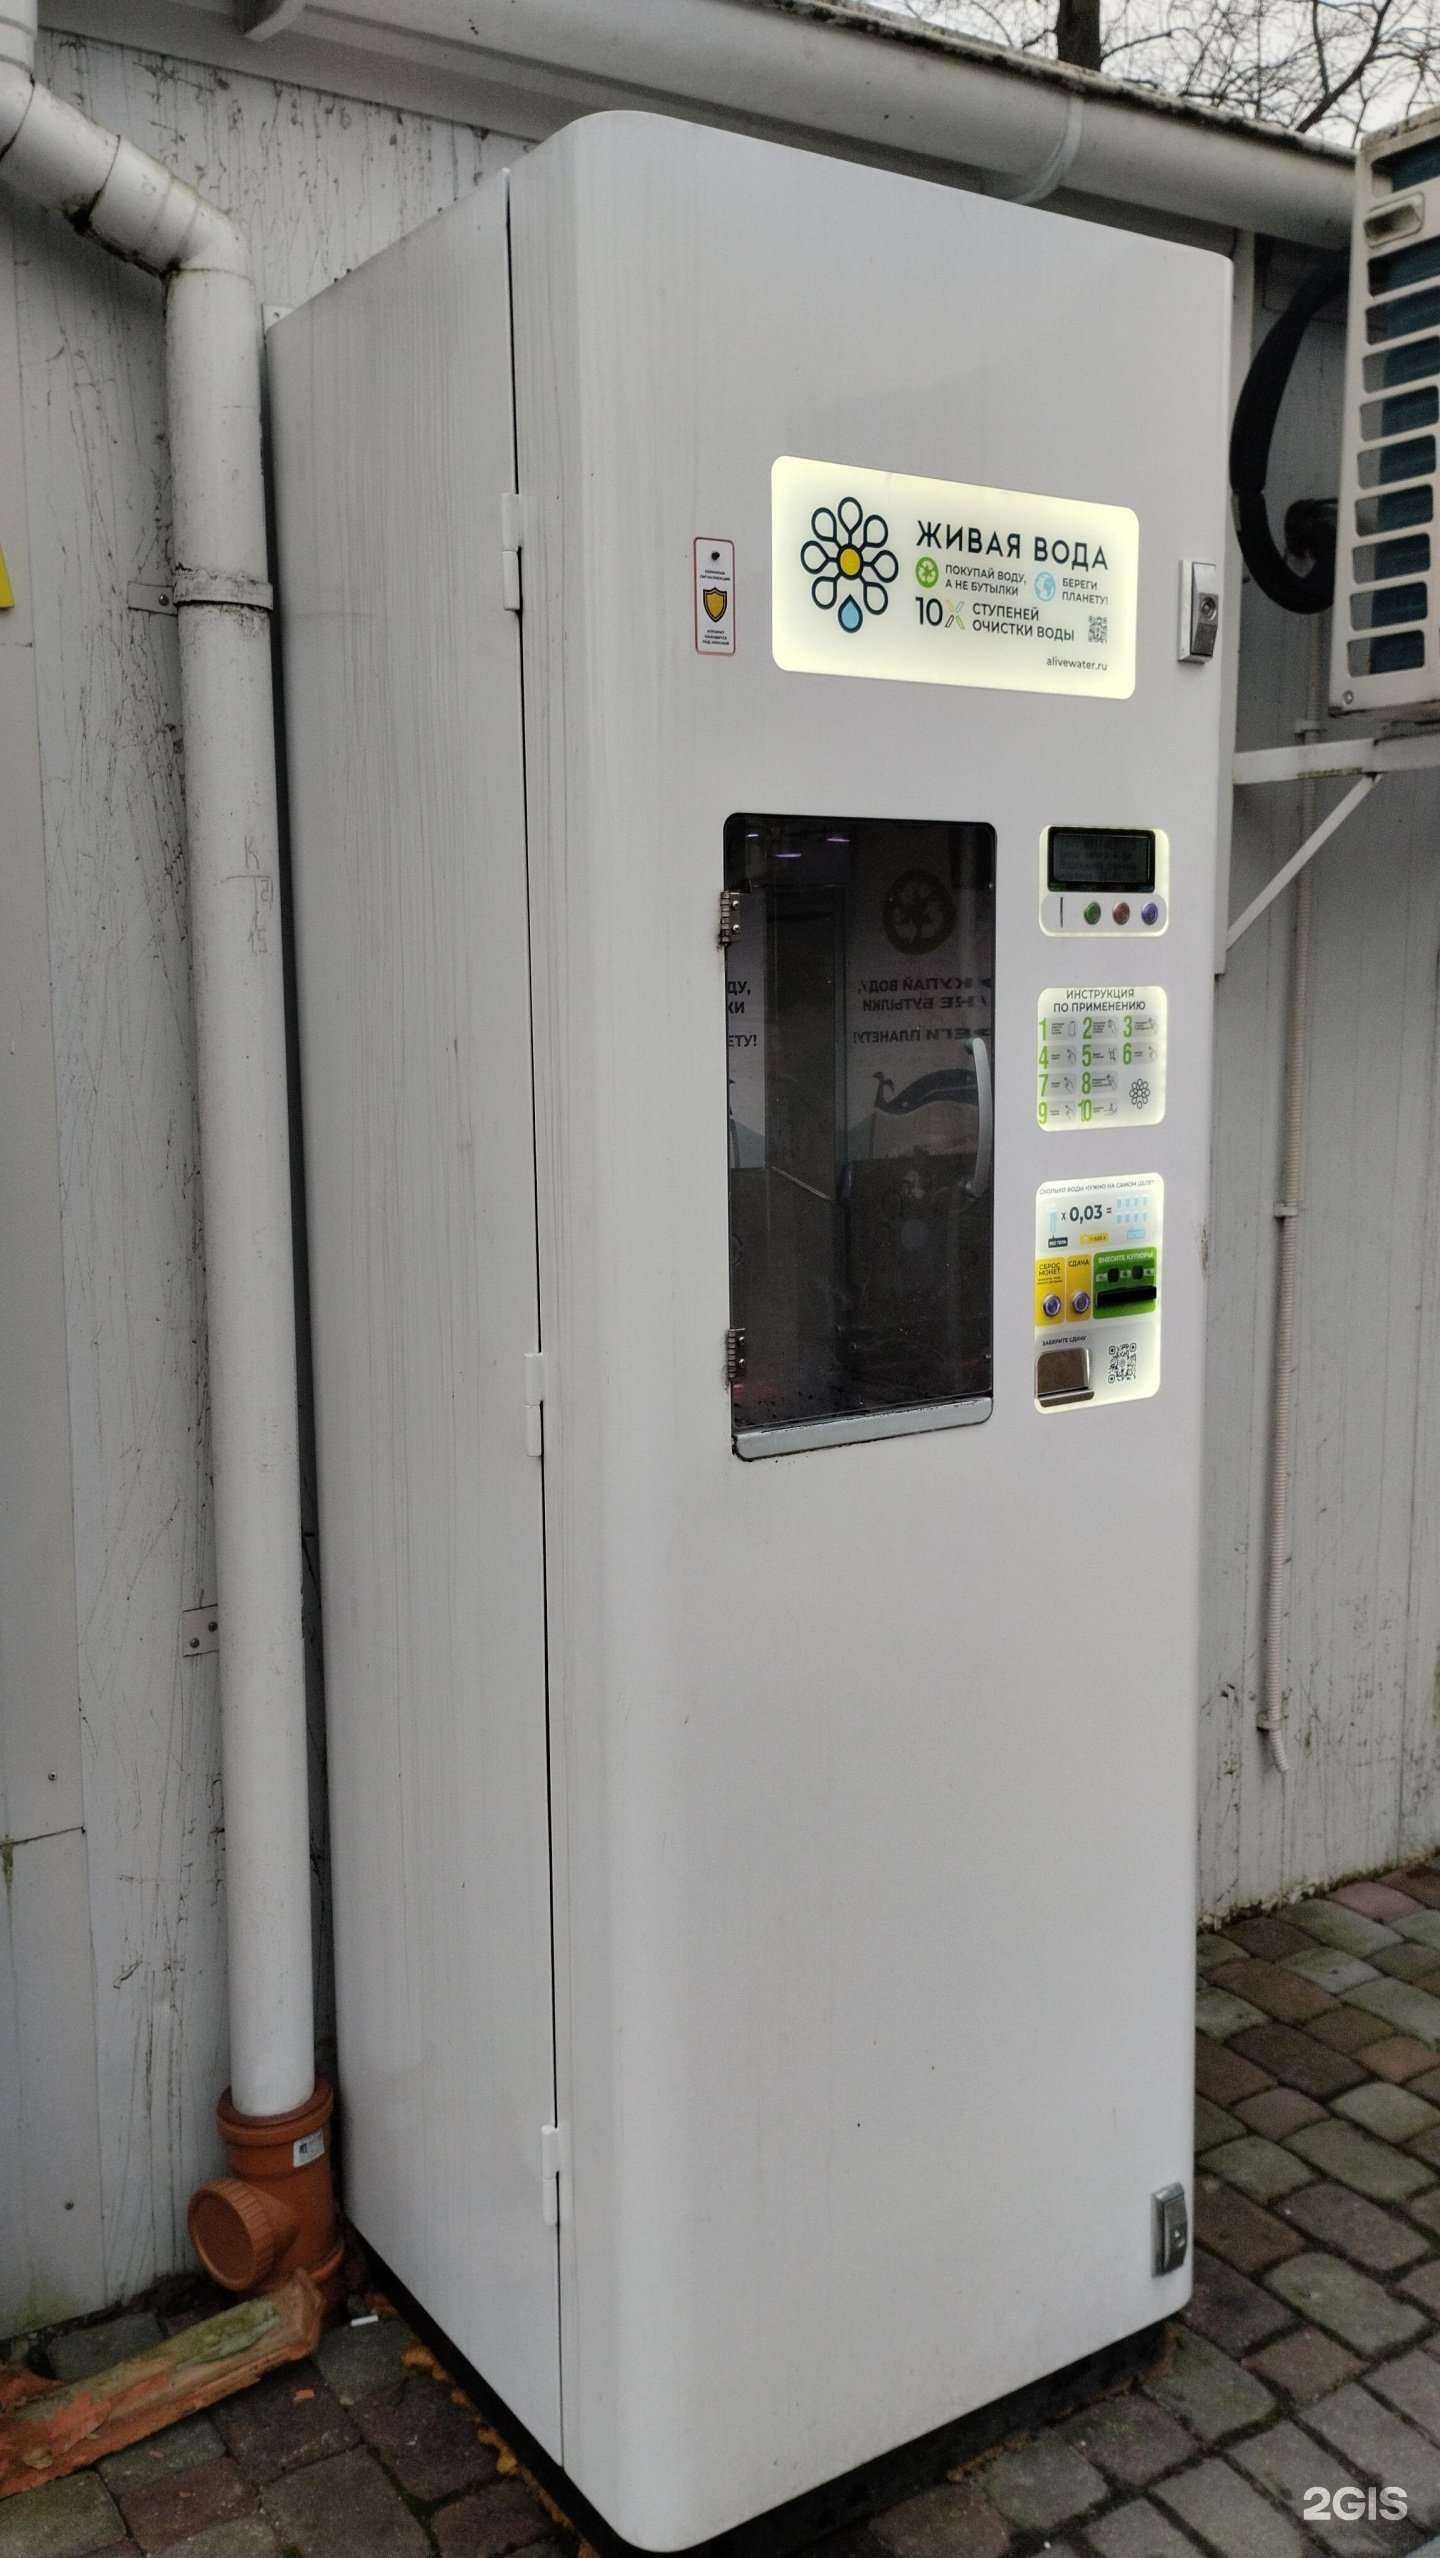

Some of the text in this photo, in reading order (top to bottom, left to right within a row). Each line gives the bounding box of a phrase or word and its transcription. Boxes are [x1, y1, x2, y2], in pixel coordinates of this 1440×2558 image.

[916, 520, 1109, 572] ЖИВАЯ ВОДА
[945, 564, 1027, 585] ПОКУПАЙ ВОДУ,
[1062, 577, 1098, 591] БЕРЕГИ
[945, 579, 1019, 597] А НЕ БУТЫЛКИ
[1062, 591, 1109, 606] ПЛАНЕТУ!
[972, 602, 1040, 622] СТУПЕНЕЙ
[972, 619, 1075, 642] ОЧИСТКИ ВОДЫ
[1046, 655, 1109, 672] alivewater.ru
[1066, 989, 1135, 1000] ИНСТРУКЦИЯ
[1053, 1001, 1146, 1013] ПО ПРИМЕНЕНИЮ
[1039, 1017, 1047, 1041] 1
[1083, 1016, 1092, 1040] 2
[1123, 1015, 1133, 1038] 3
[1039, 1046, 1049, 1070] 4
[1082, 1044, 1092, 1067] 5
[1123, 1042, 1132, 1065] 6
[1039, 1074, 1049, 1097] 7
[1082, 1071, 1091, 1095] 8
[1039, 1101, 1048, 1125] 9
[1078, 1099, 1092, 1122] 10
[1069, 1204, 1103, 1224] 0,03
[1068, 1259, 1089, 1268] СДАЧА
